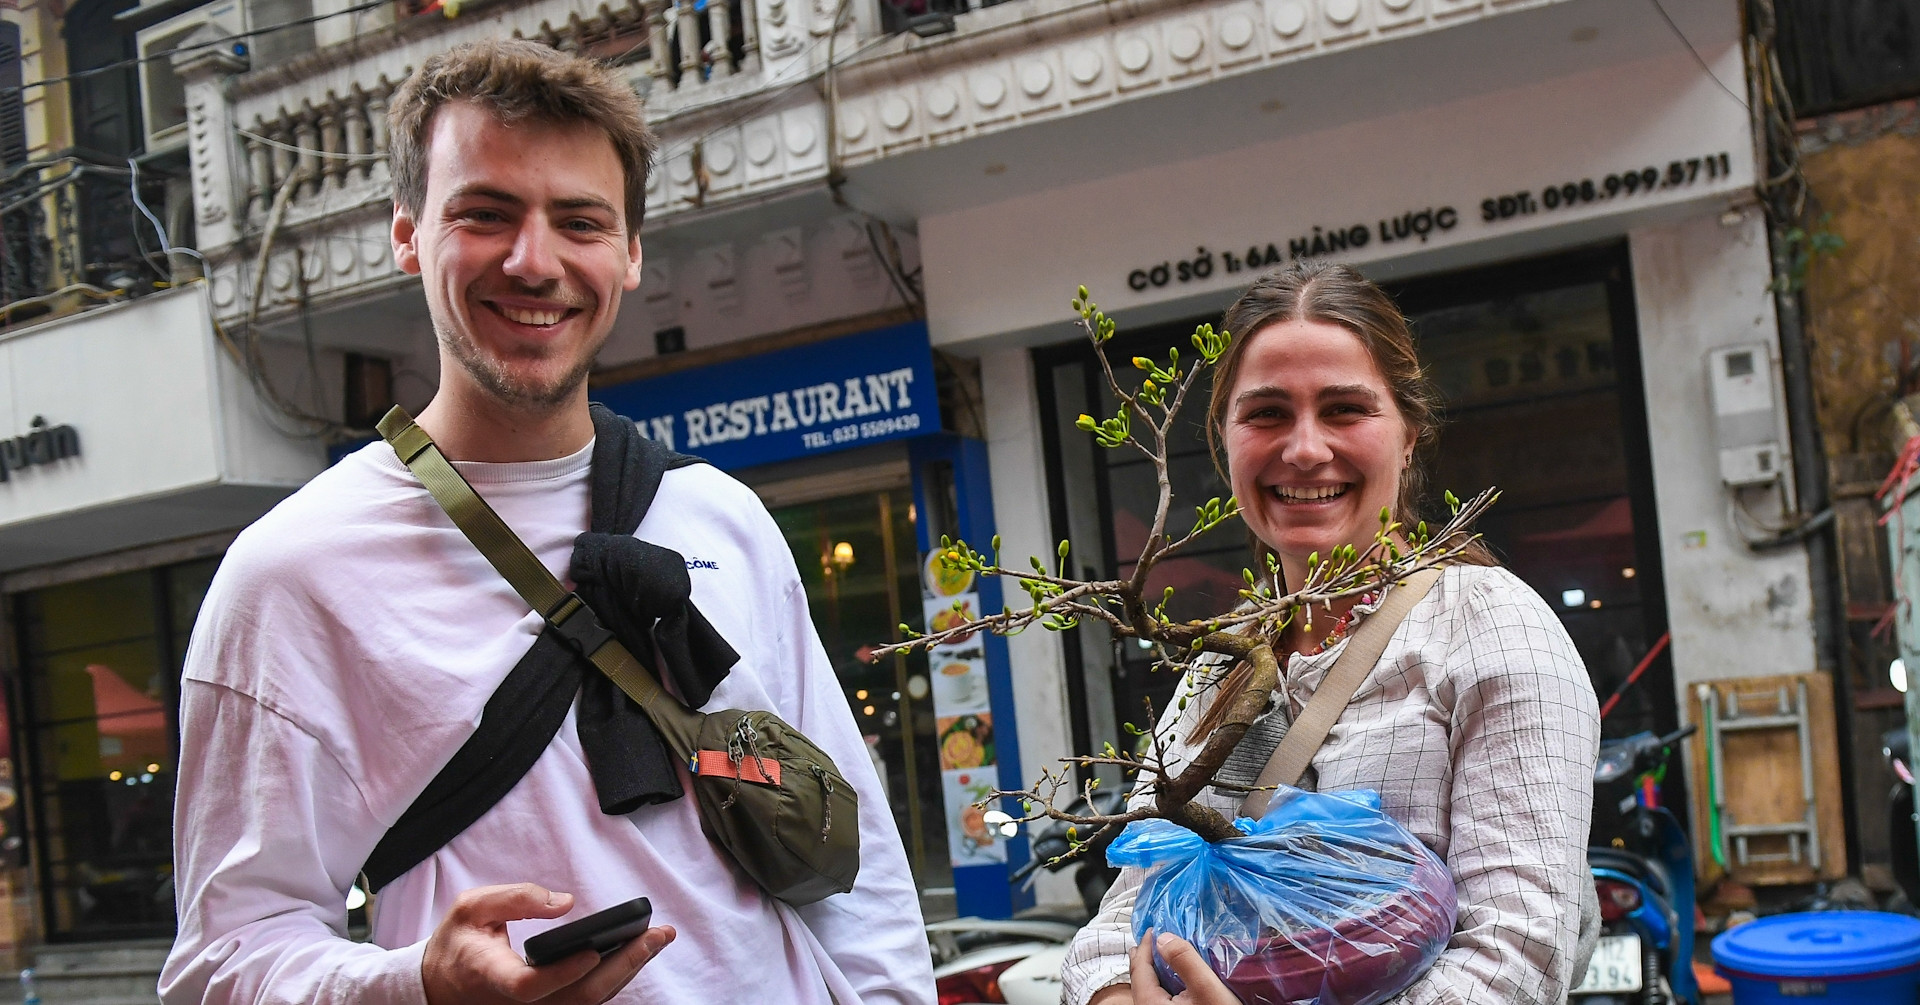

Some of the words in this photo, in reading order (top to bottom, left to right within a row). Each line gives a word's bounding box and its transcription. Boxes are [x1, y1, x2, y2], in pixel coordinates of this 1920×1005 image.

[1542, 152, 1731, 211] 098.999.5711
[1127, 262, 1171, 292] CƠ
[1177, 246, 1214, 284] SỞ
[1245, 243, 1282, 269] 6A
[1288, 226, 1371, 260] HÀNG
[1379, 206, 1458, 243] LƯỢC
[684, 366, 914, 449] RESTAURANT
[801, 431, 832, 450] TEL:
[832, 423, 860, 444] 033
